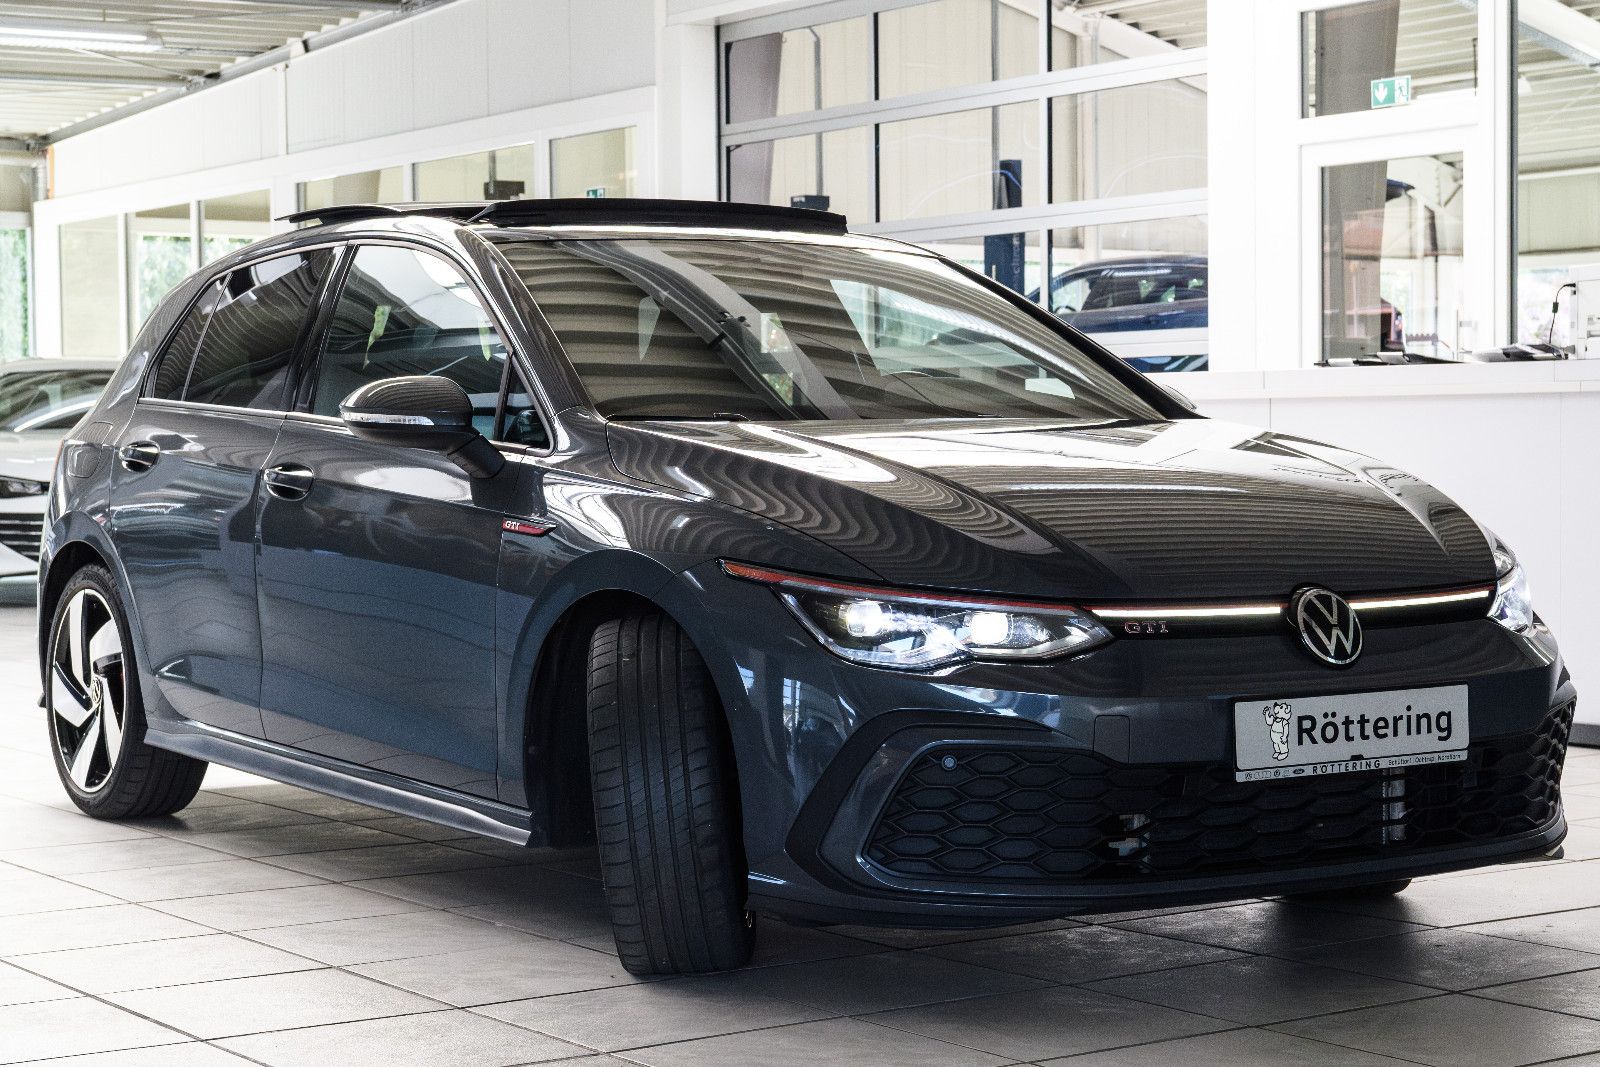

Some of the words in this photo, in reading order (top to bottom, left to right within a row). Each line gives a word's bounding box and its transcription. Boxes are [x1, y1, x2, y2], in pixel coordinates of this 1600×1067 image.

[505, 520, 521, 531] GTI
[1124, 620, 1169, 634] GTI
[1297, 704, 1452, 746] Röttering
[1312, 759, 1381, 775] RÖTTERING
